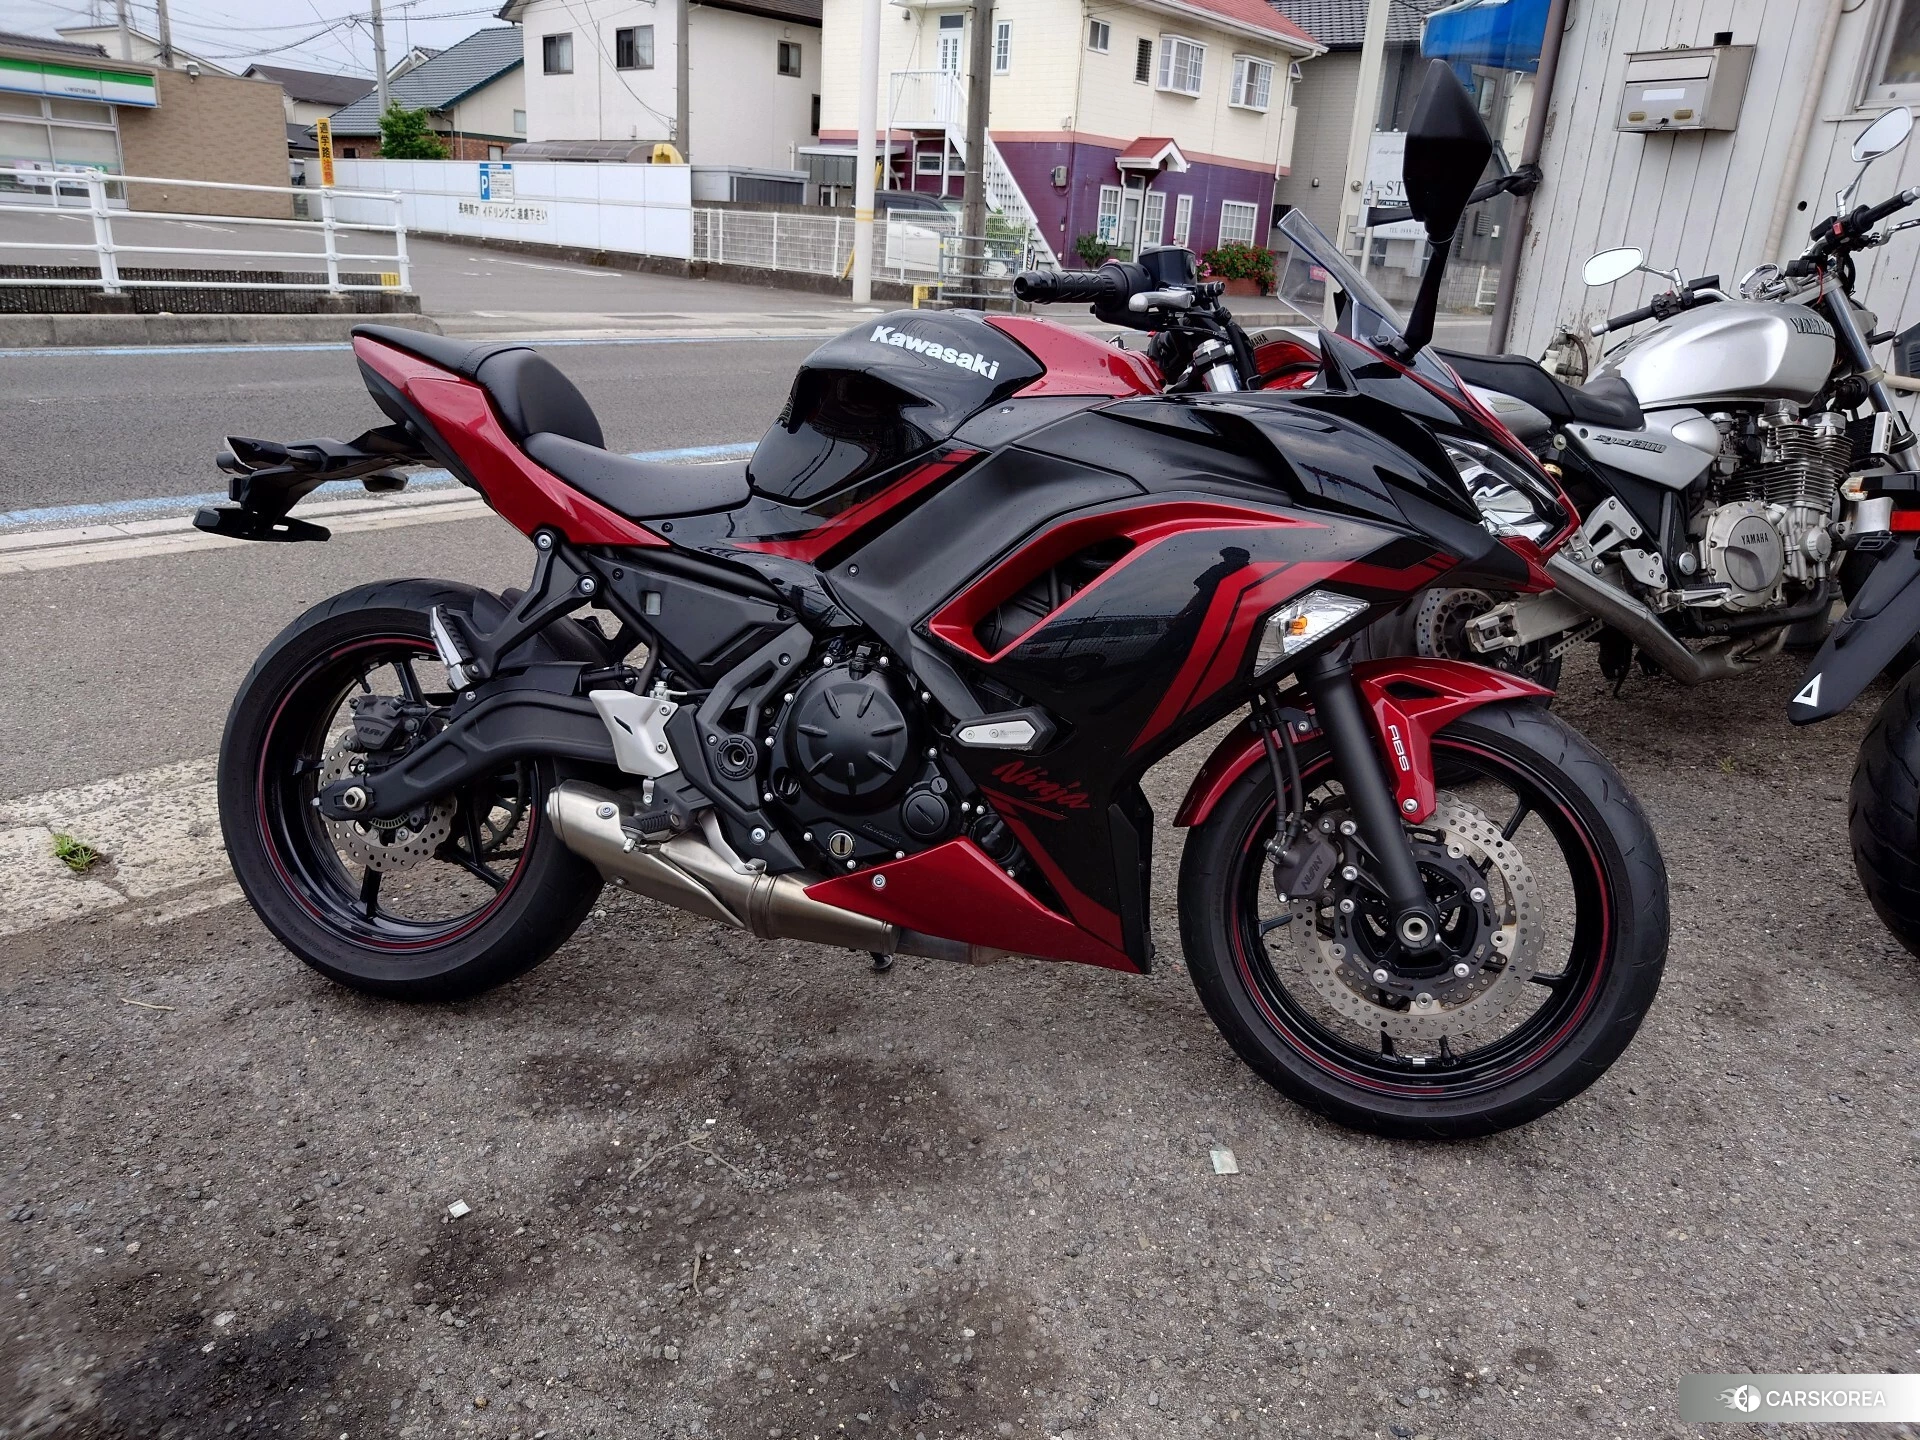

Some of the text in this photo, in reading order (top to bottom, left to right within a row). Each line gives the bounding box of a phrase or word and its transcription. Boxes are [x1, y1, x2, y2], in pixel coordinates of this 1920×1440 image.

[481, 175, 489, 195] P
[869, 325, 1000, 381] Kawasaki
[1741, 532, 1769, 545] YAMAHA
[1387, 724, 1410, 771] ABS
[991, 760, 1090, 808] Ninja
